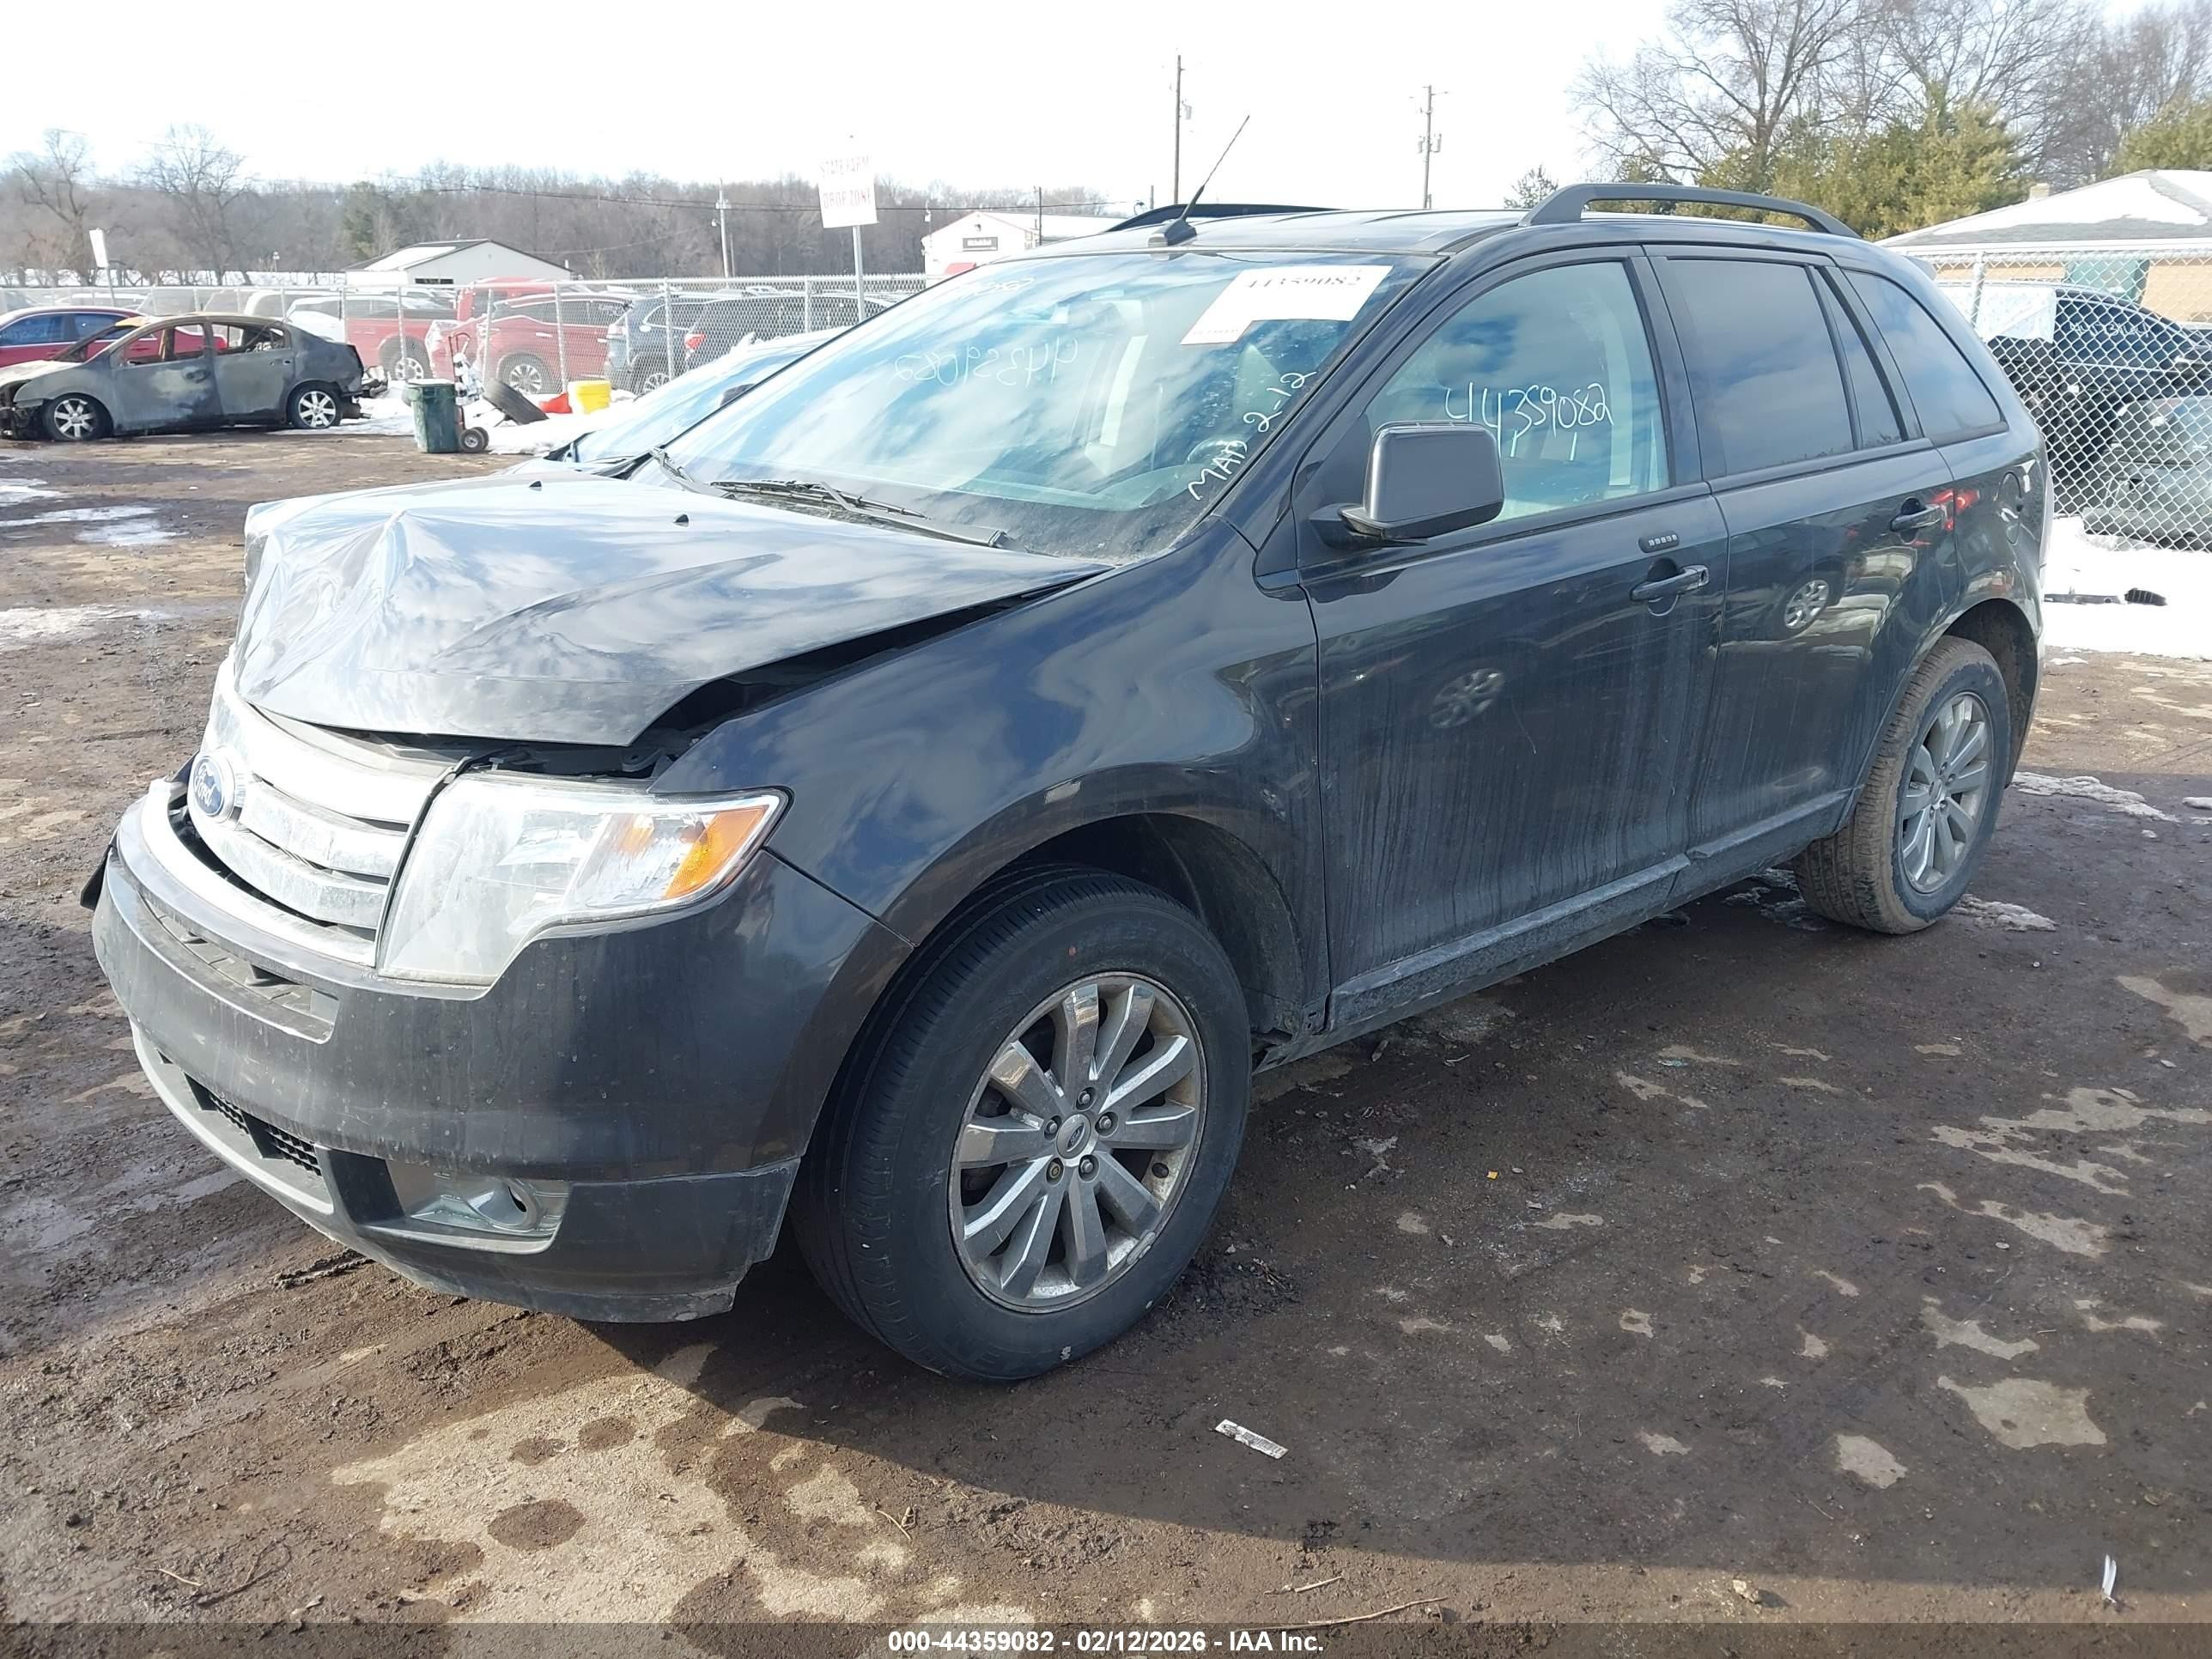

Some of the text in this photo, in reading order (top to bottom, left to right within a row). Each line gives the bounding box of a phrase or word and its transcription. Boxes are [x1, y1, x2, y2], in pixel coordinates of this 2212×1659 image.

[823, 186, 872, 210] DROP ZONE
[1243, 371, 1318, 433] 2-12
[1445, 381, 1614, 460] 44359082
[195, 763, 217, 807] Ford
